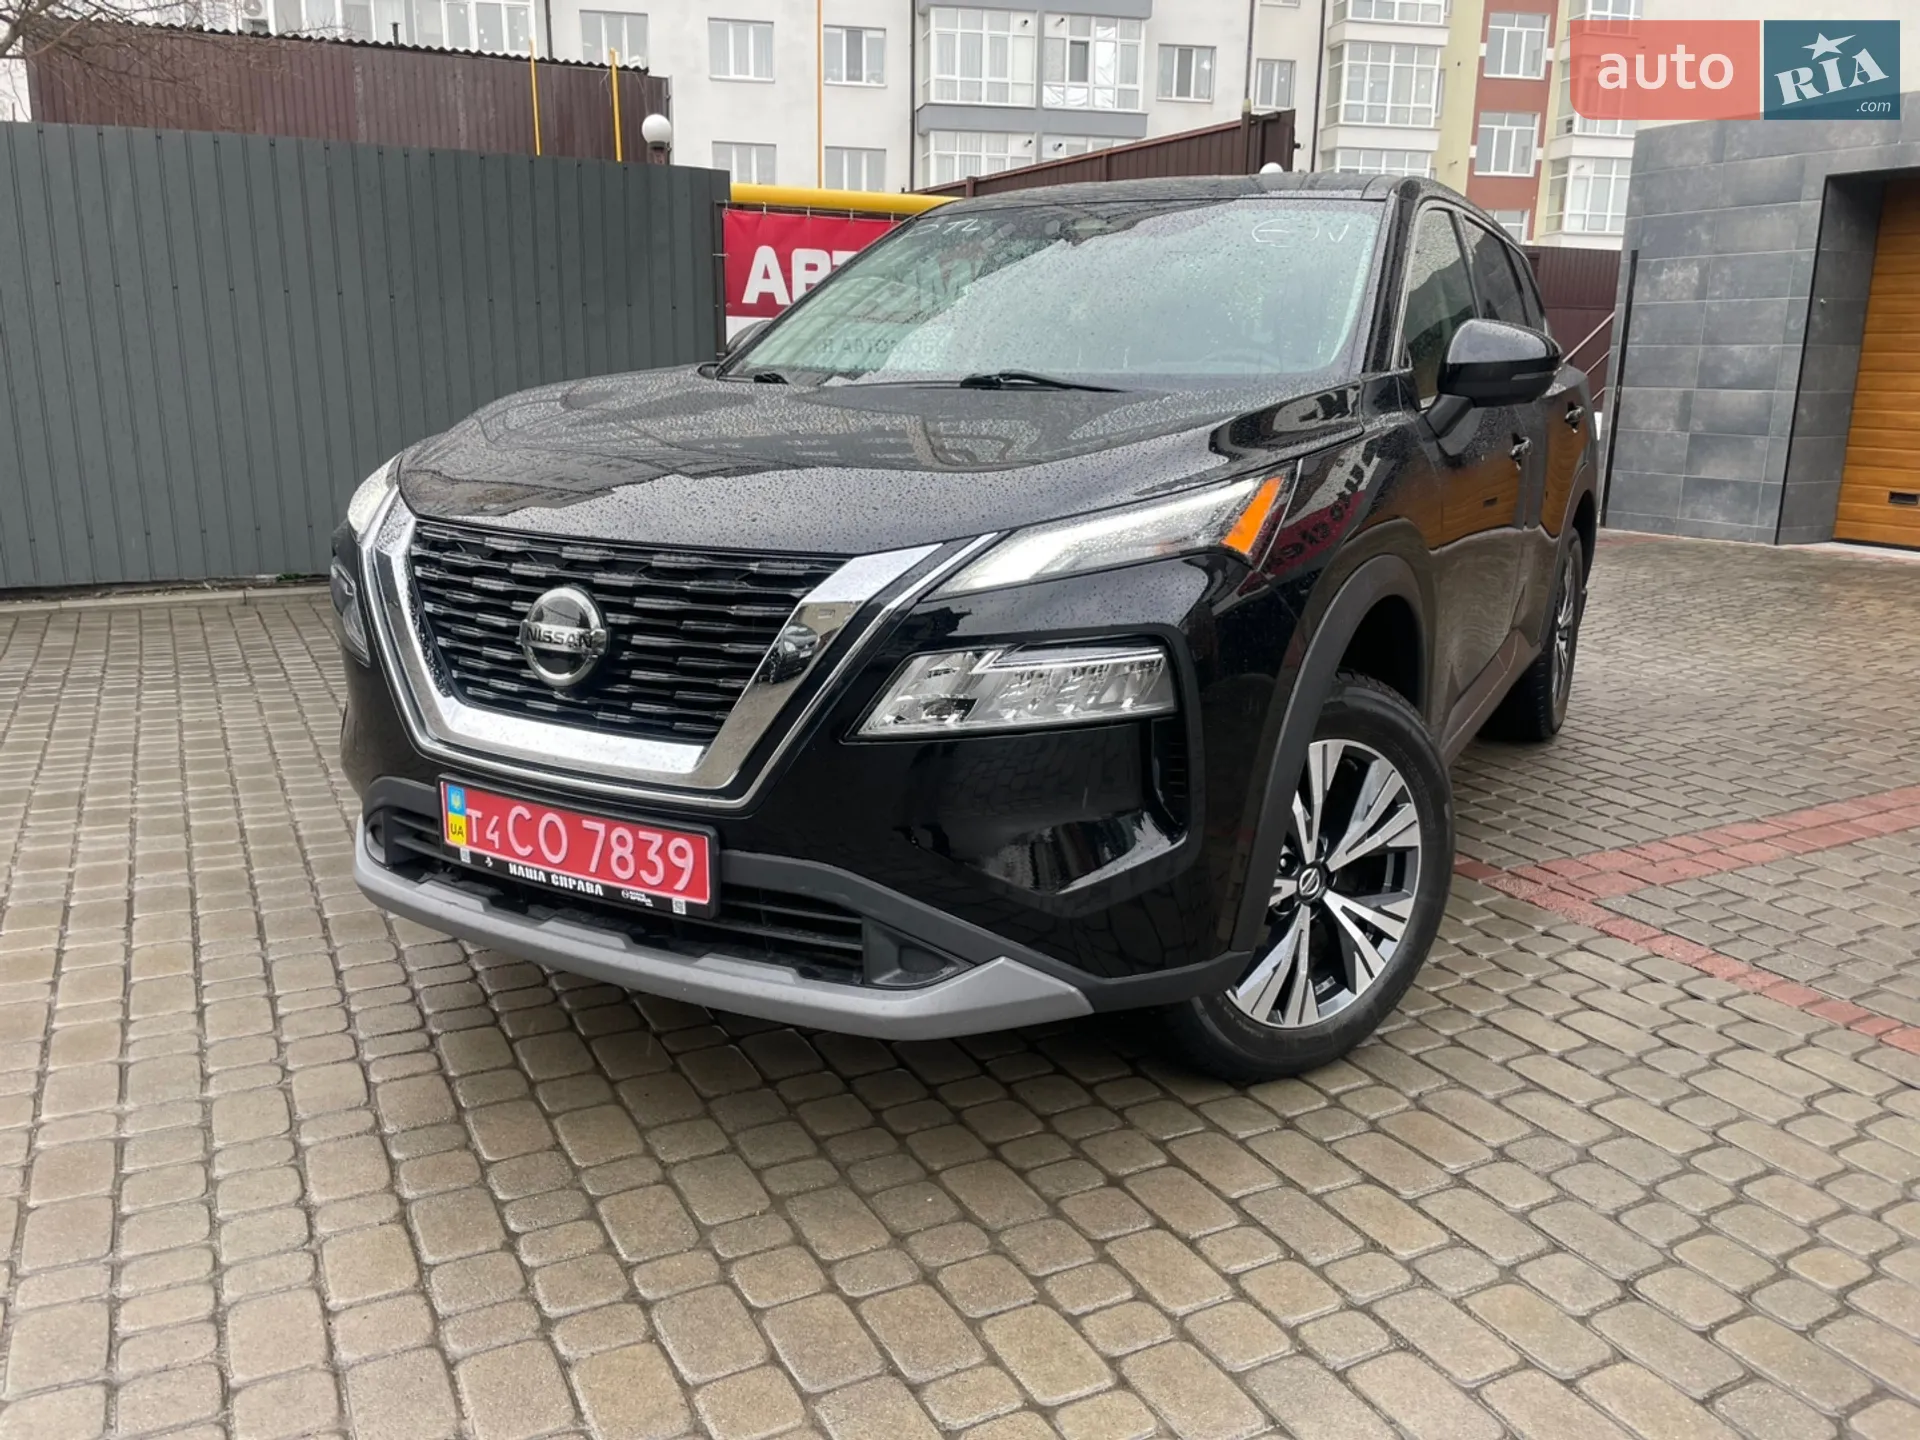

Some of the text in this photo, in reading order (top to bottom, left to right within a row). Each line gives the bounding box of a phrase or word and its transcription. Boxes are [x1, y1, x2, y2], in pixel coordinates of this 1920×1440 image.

[527, 627, 594, 648] NISSAN
[450, 823, 464, 838] UA
[581, 820, 695, 891] 7839
[508, 862, 604, 897] НАША СПРАВА
